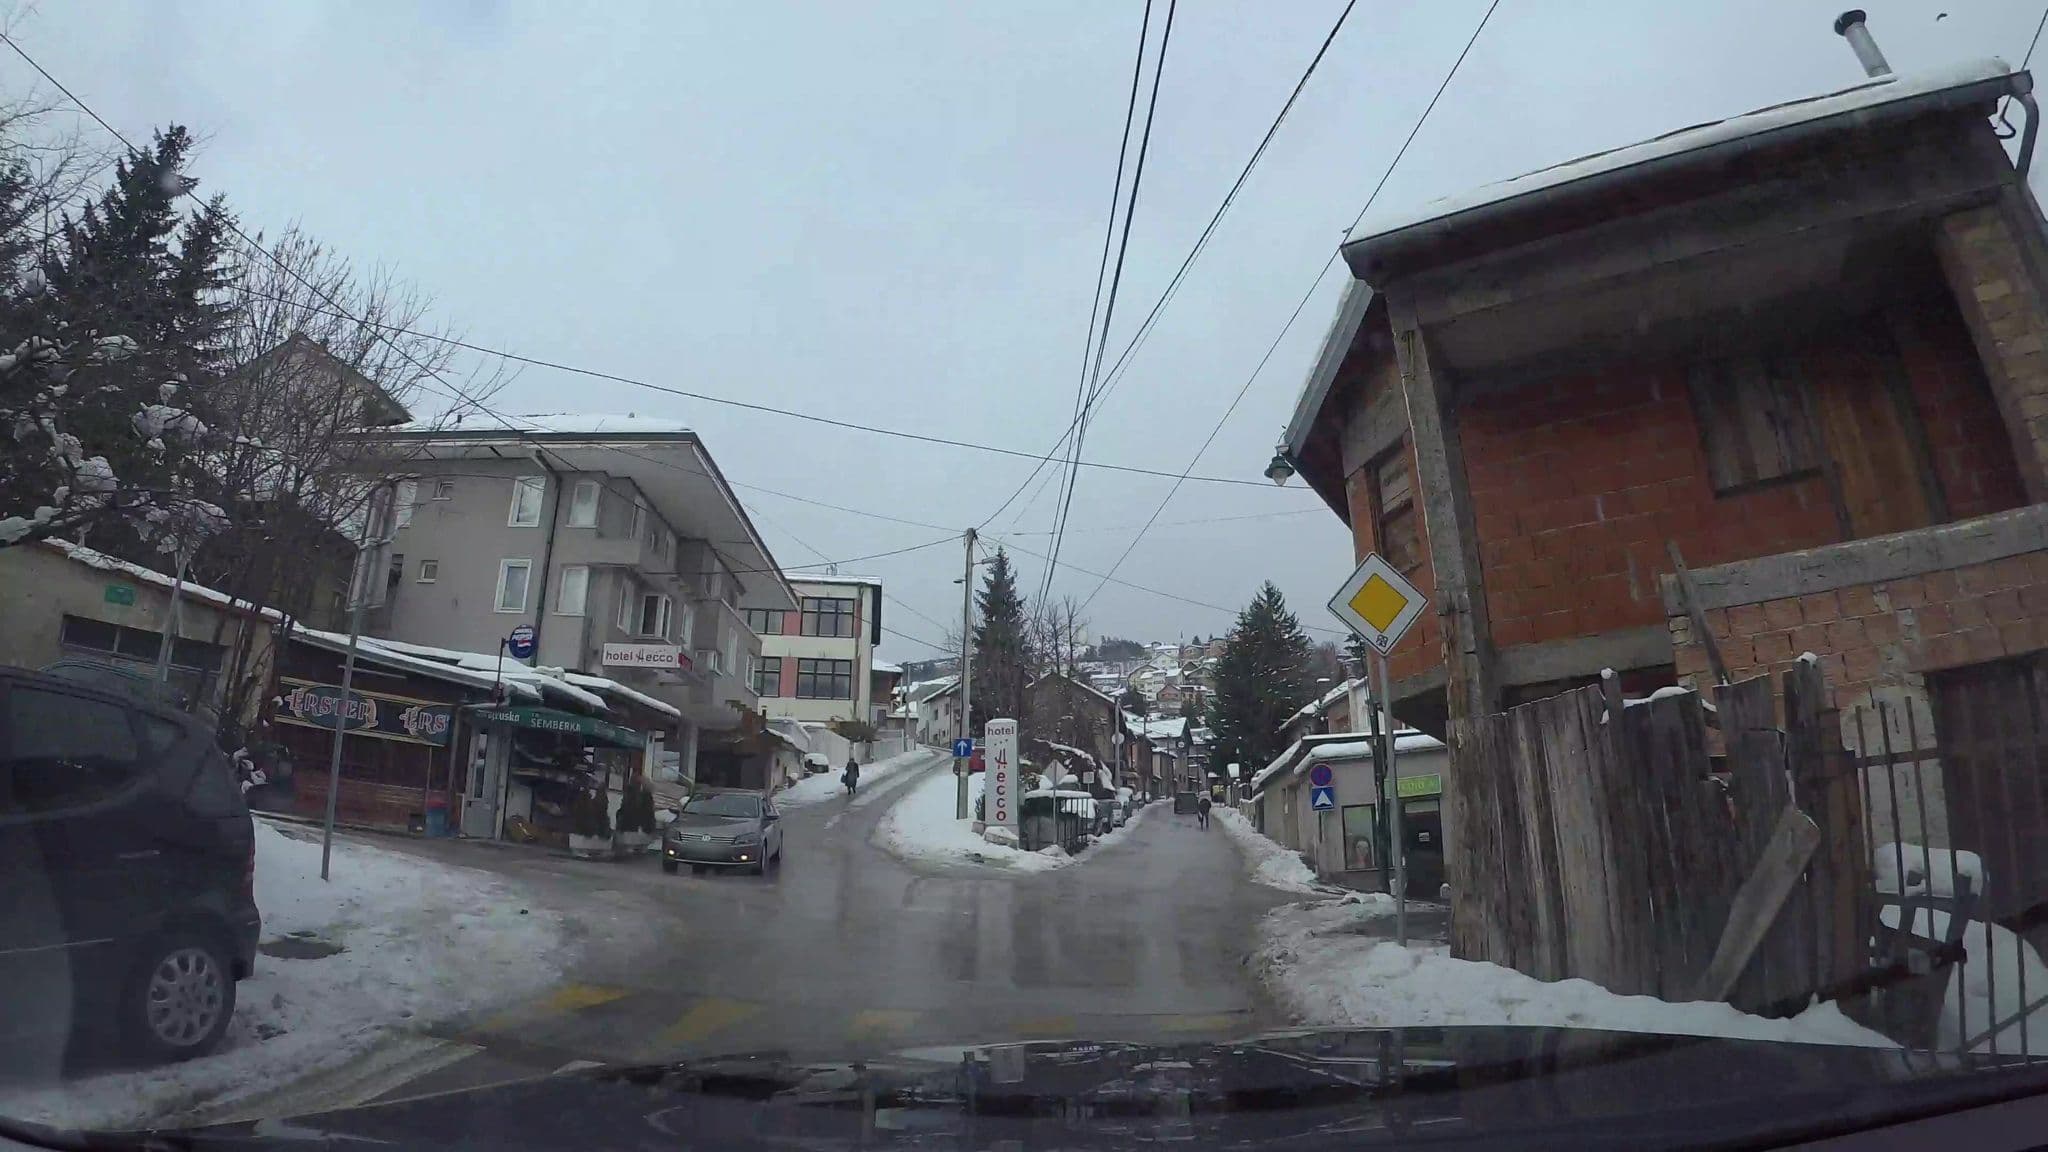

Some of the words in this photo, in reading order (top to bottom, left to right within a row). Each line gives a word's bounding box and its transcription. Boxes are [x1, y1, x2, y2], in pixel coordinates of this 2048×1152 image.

[605, 650, 633, 661] hotel
[398, 705, 450, 735] ERS
[987, 726, 1015, 736] hotel
